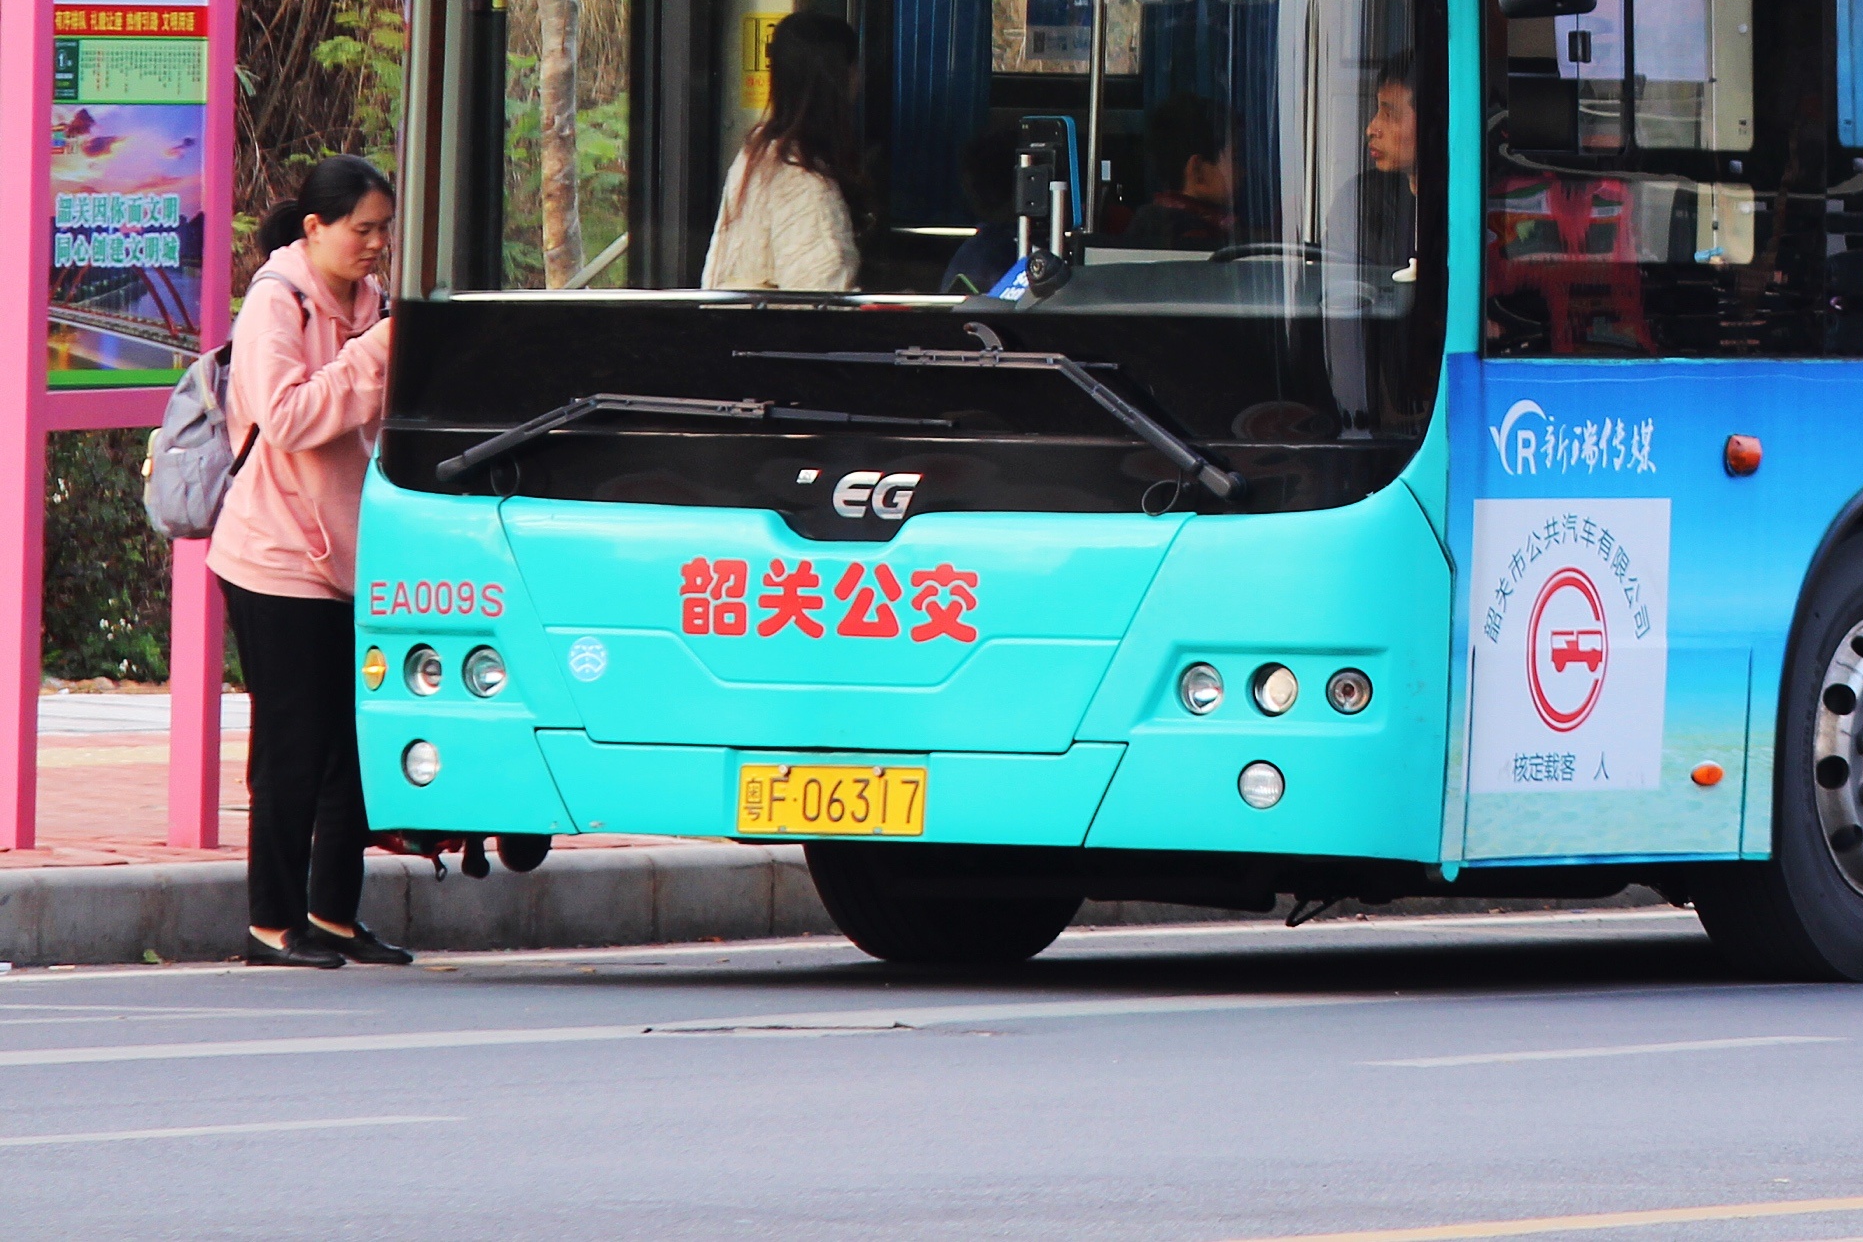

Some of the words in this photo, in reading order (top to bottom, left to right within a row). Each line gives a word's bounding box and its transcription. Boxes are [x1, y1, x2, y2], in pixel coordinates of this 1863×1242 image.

[55, 192, 180, 228] 韶关因你而文明
[55, 233, 180, 268] 同心创建文明城
[1540, 416, 1657, 475] 新瑞传媒
[832, 469, 924, 521] EG
[369, 581, 505, 618] EA009S
[678, 556, 980, 644] 韶关公交
[1482, 512, 1651, 644] 韶关市公共汽车有限公司
[1512, 751, 1578, 784] 核定载客
[1592, 753, 1610, 782] 人
